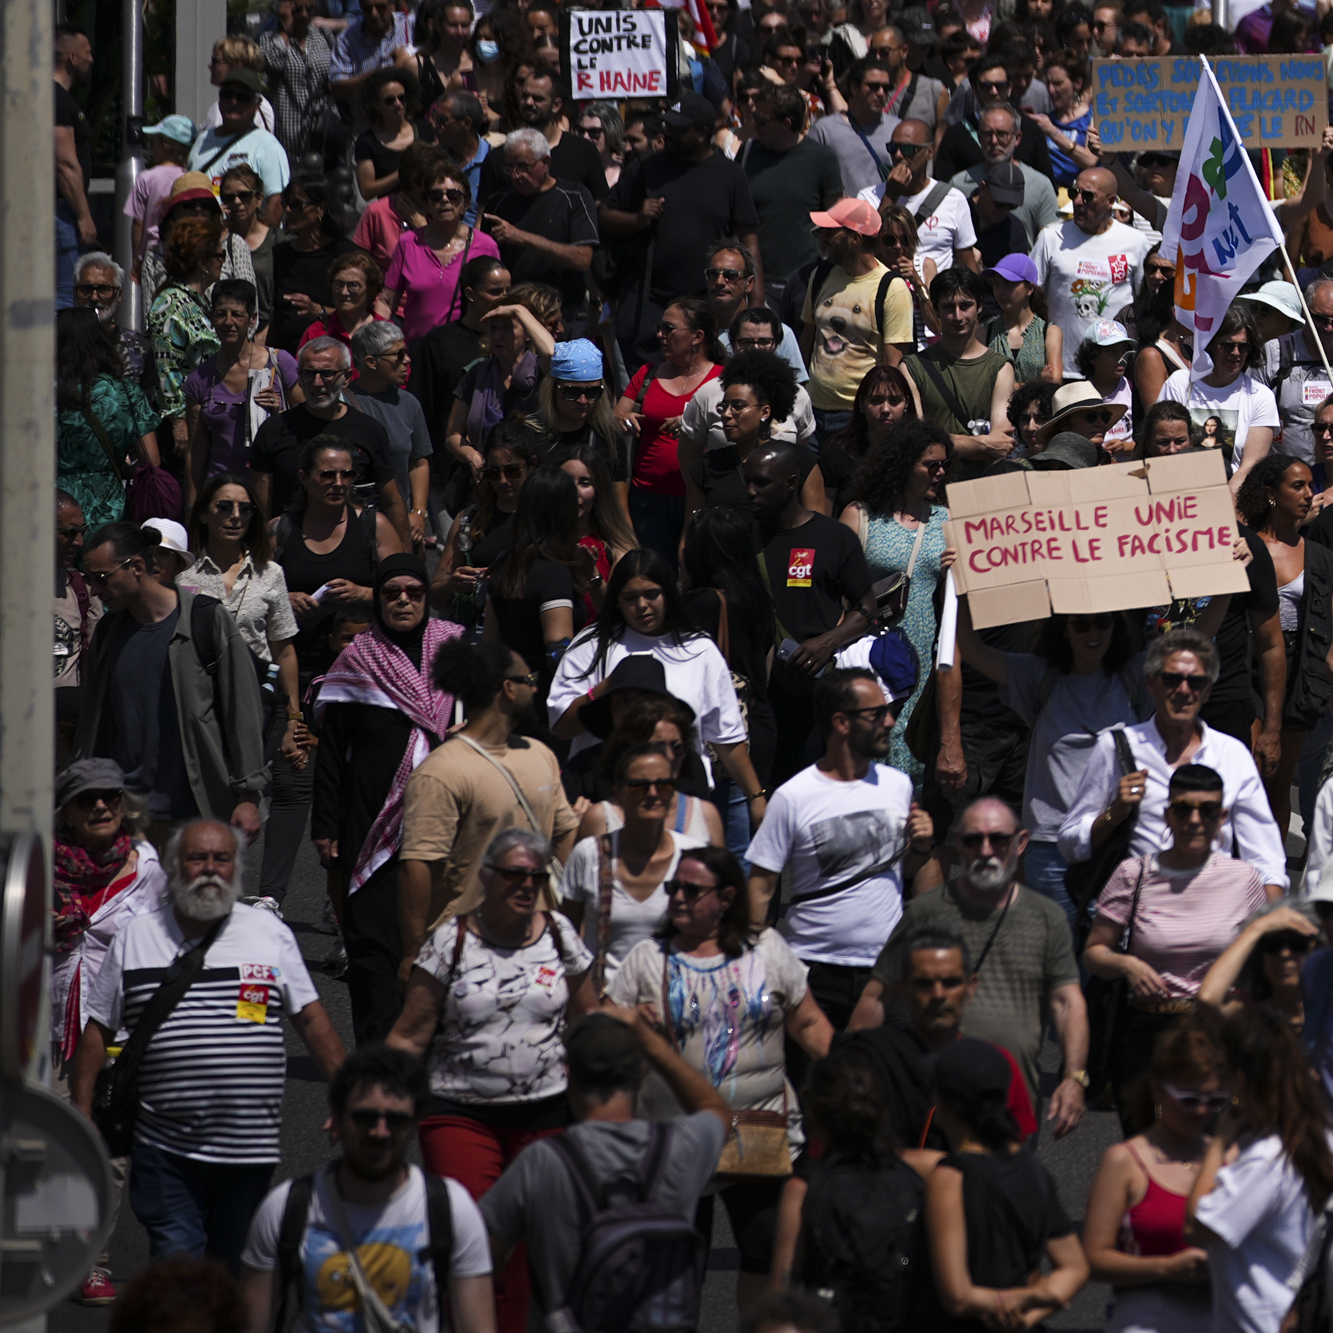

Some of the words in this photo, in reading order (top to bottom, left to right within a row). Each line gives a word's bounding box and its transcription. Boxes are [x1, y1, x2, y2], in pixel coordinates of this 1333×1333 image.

[573, 33, 652, 55] CONTRE
[577, 56, 597, 70] LE
[1280, 59, 1325, 83] NOUS
[1228, 86, 1315, 113] PLACARD
[1098, 117, 1158, 145] QU'ON
[1161, 119, 1175, 144] Y
[1261, 114, 1284, 139] LE
[1295, 114, 1316, 137] RN
[968, 536, 1064, 574] CONTRE
[1072, 537, 1104, 564] LE
[788, 564, 813, 579] cgt
[242, 965, 271, 980] PCF
[243, 990, 264, 1004] cgt
